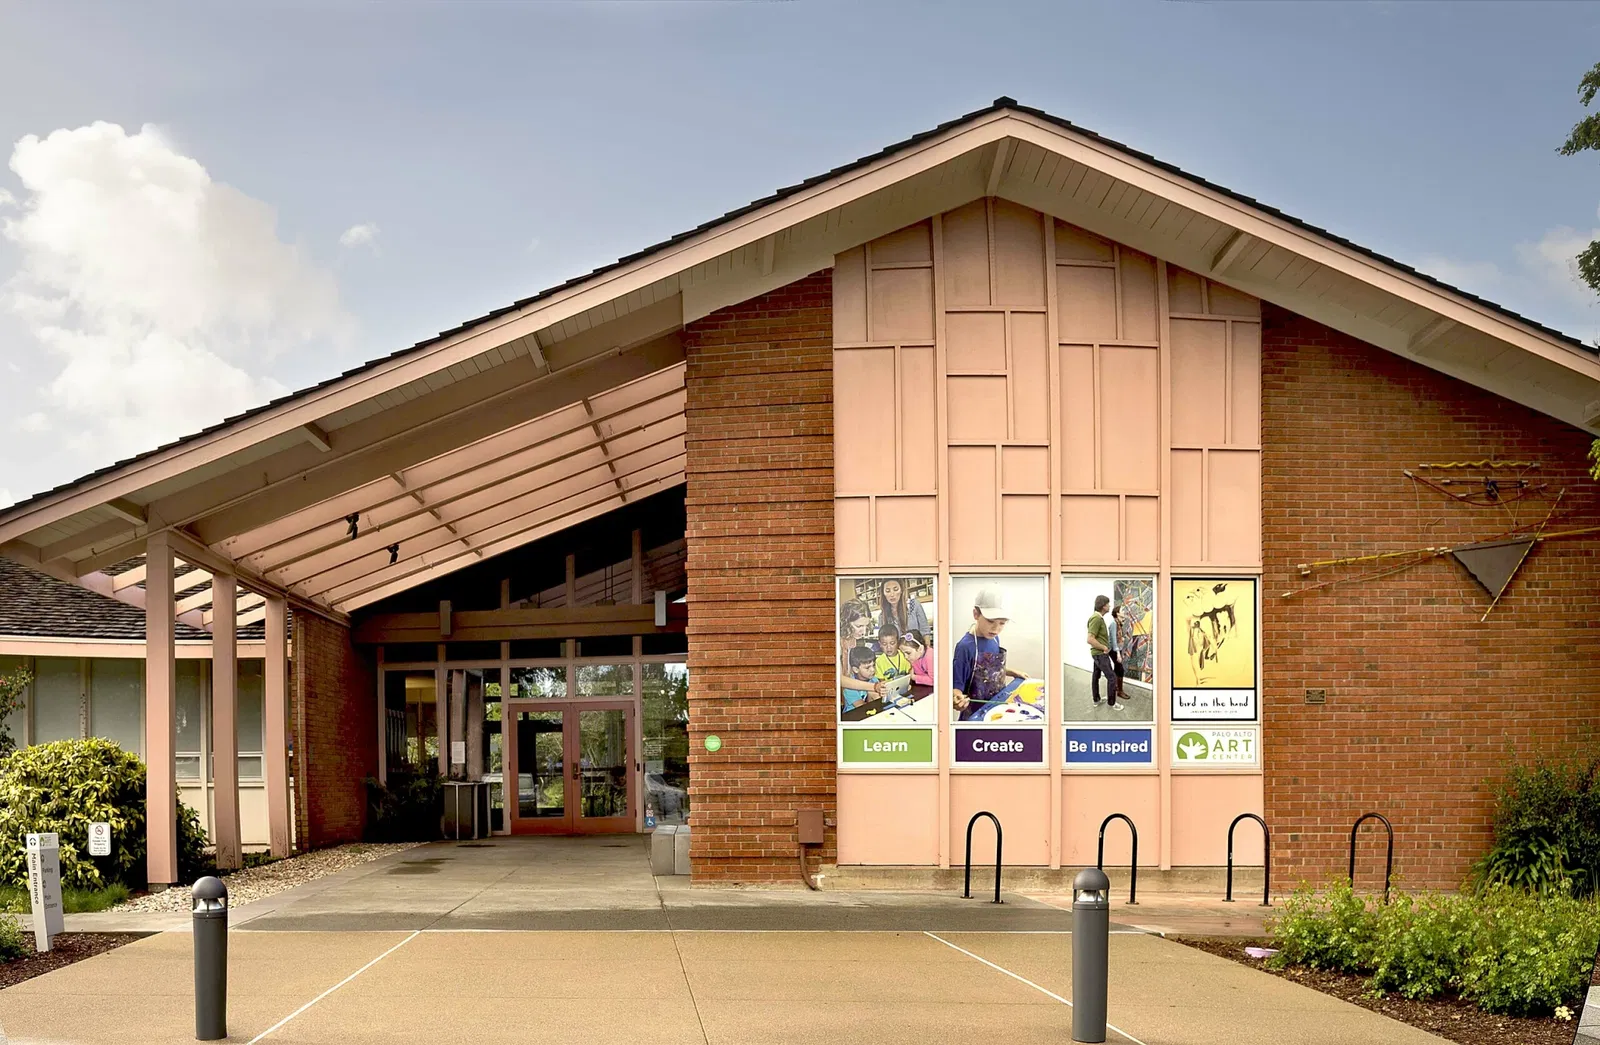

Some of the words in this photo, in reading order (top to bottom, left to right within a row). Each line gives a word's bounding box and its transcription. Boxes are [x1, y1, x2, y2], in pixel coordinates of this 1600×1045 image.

[1179, 696, 1197, 707] bird
[1213, 697, 1226, 707] the
[1229, 696, 1249, 707] hand
[863, 739, 908, 752] Learn
[972, 739, 1024, 752] Create
[1069, 740, 1087, 752] Be
[1092, 740, 1148, 755] Inspired
[1212, 739, 1252, 752] ART
